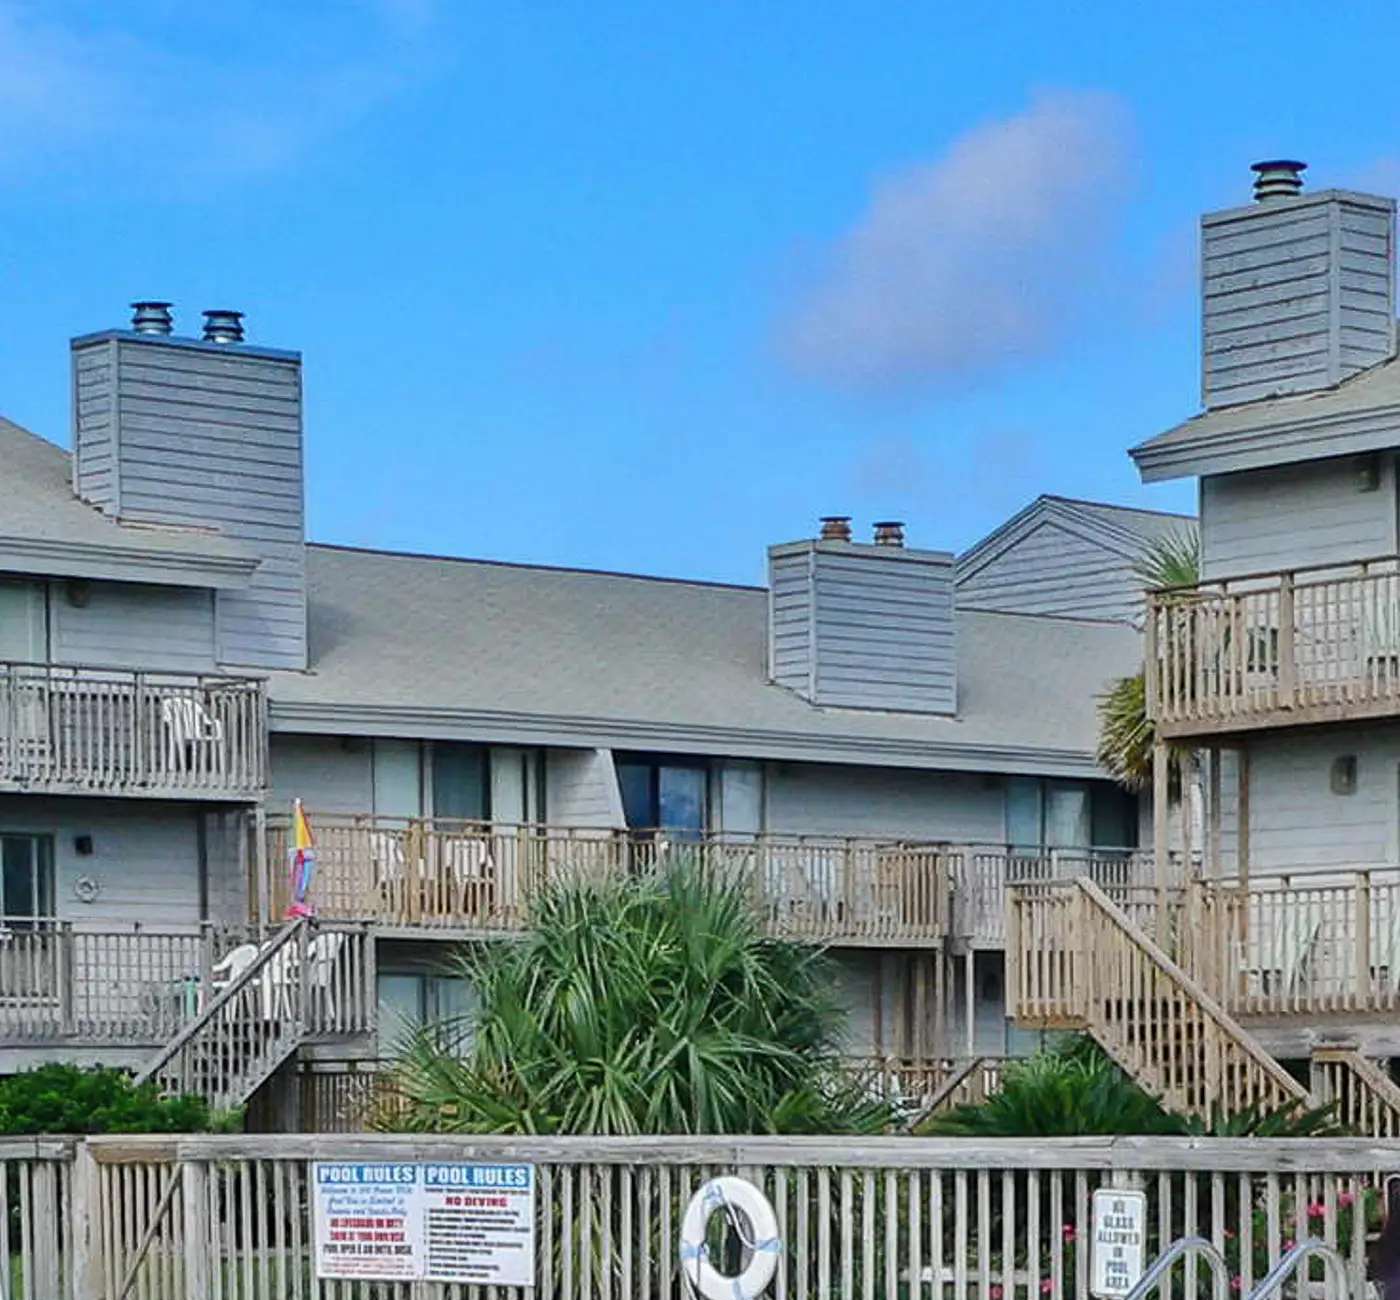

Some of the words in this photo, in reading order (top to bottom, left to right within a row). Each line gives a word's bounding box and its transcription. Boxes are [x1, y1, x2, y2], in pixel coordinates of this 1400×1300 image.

[319, 1165, 360, 1182] POOL
[362, 1165, 414, 1182] RULES
[427, 1166, 469, 1184] POOL
[472, 1167, 526, 1186] RULES
[445, 1196, 461, 1206] NO
[464, 1196, 507, 1207] DIVING
[1113, 1200, 1125, 1213] NO
[1103, 1215, 1134, 1229] GLASS
[1097, 1231, 1139, 1245] ALLOWED
[1106, 1260, 1128, 1274] POOL
[1105, 1276, 1129, 1289] AREA
